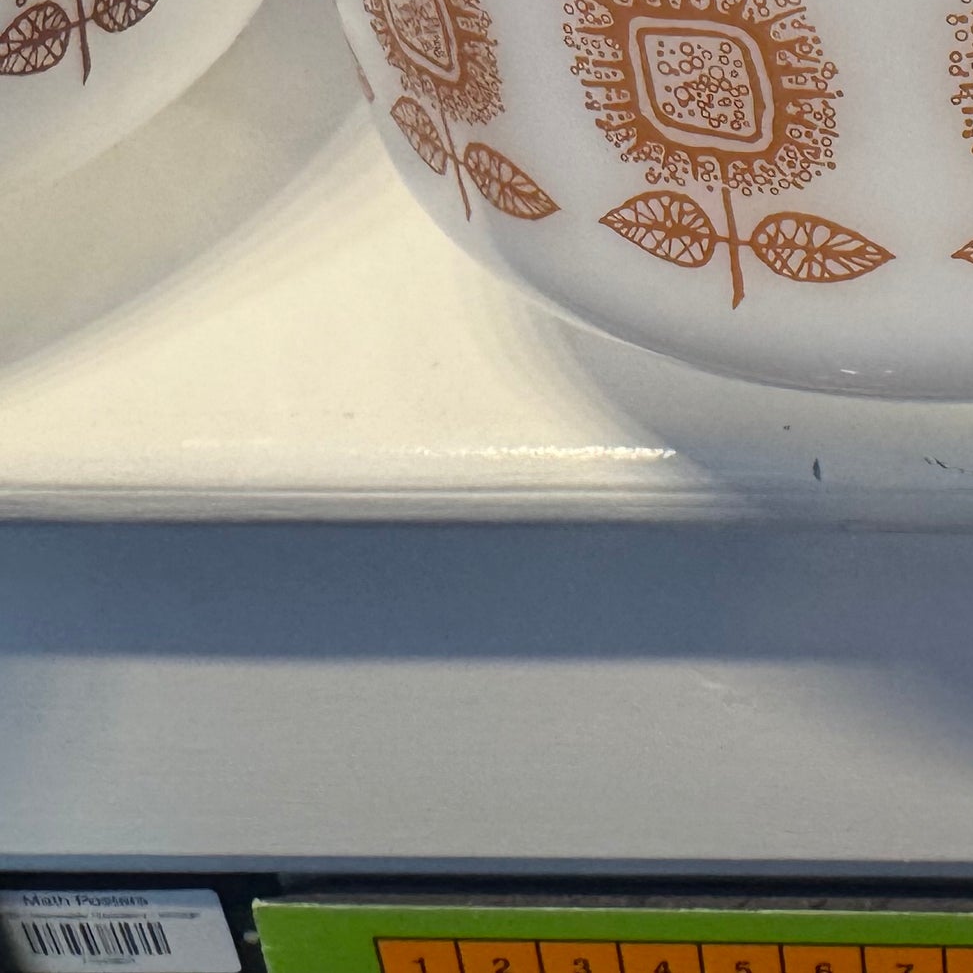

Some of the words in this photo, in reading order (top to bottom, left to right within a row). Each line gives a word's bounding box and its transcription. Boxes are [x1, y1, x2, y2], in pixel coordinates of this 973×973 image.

[22, 893, 71, 908] Math
[76, 894, 149, 908] Posters
[492, 958, 511, 973] 2
